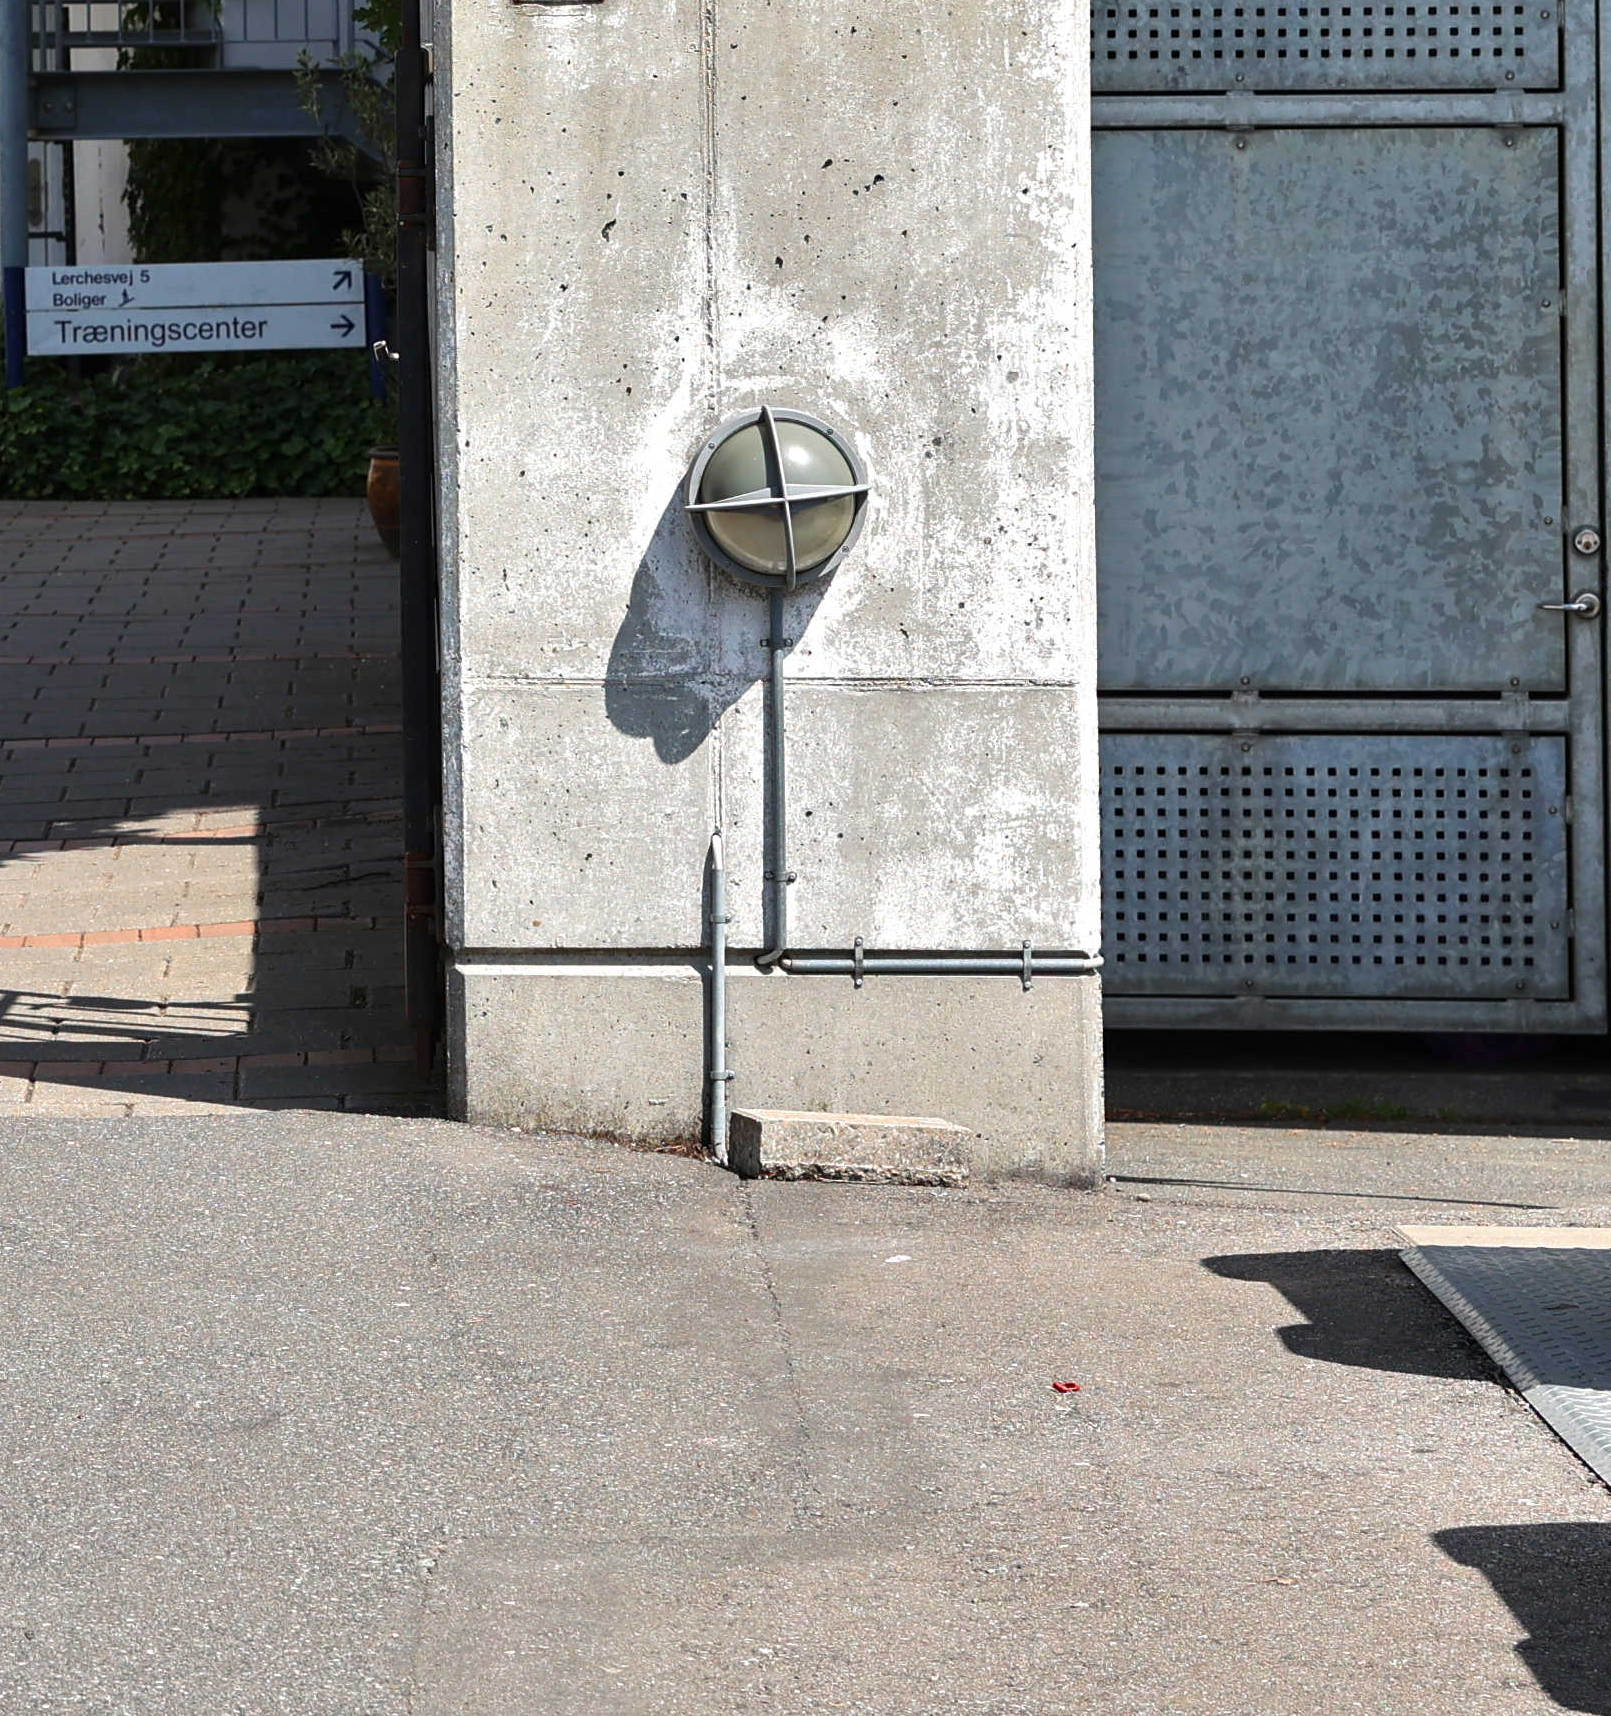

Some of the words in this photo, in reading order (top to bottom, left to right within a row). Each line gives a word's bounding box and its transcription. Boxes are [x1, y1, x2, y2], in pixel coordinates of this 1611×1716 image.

[51, 270, 133, 286] Lerchesvej
[140, 269, 151, 284] 5
[52, 292, 107, 309] Boliger
[55, 317, 268, 347] Træningscenter
